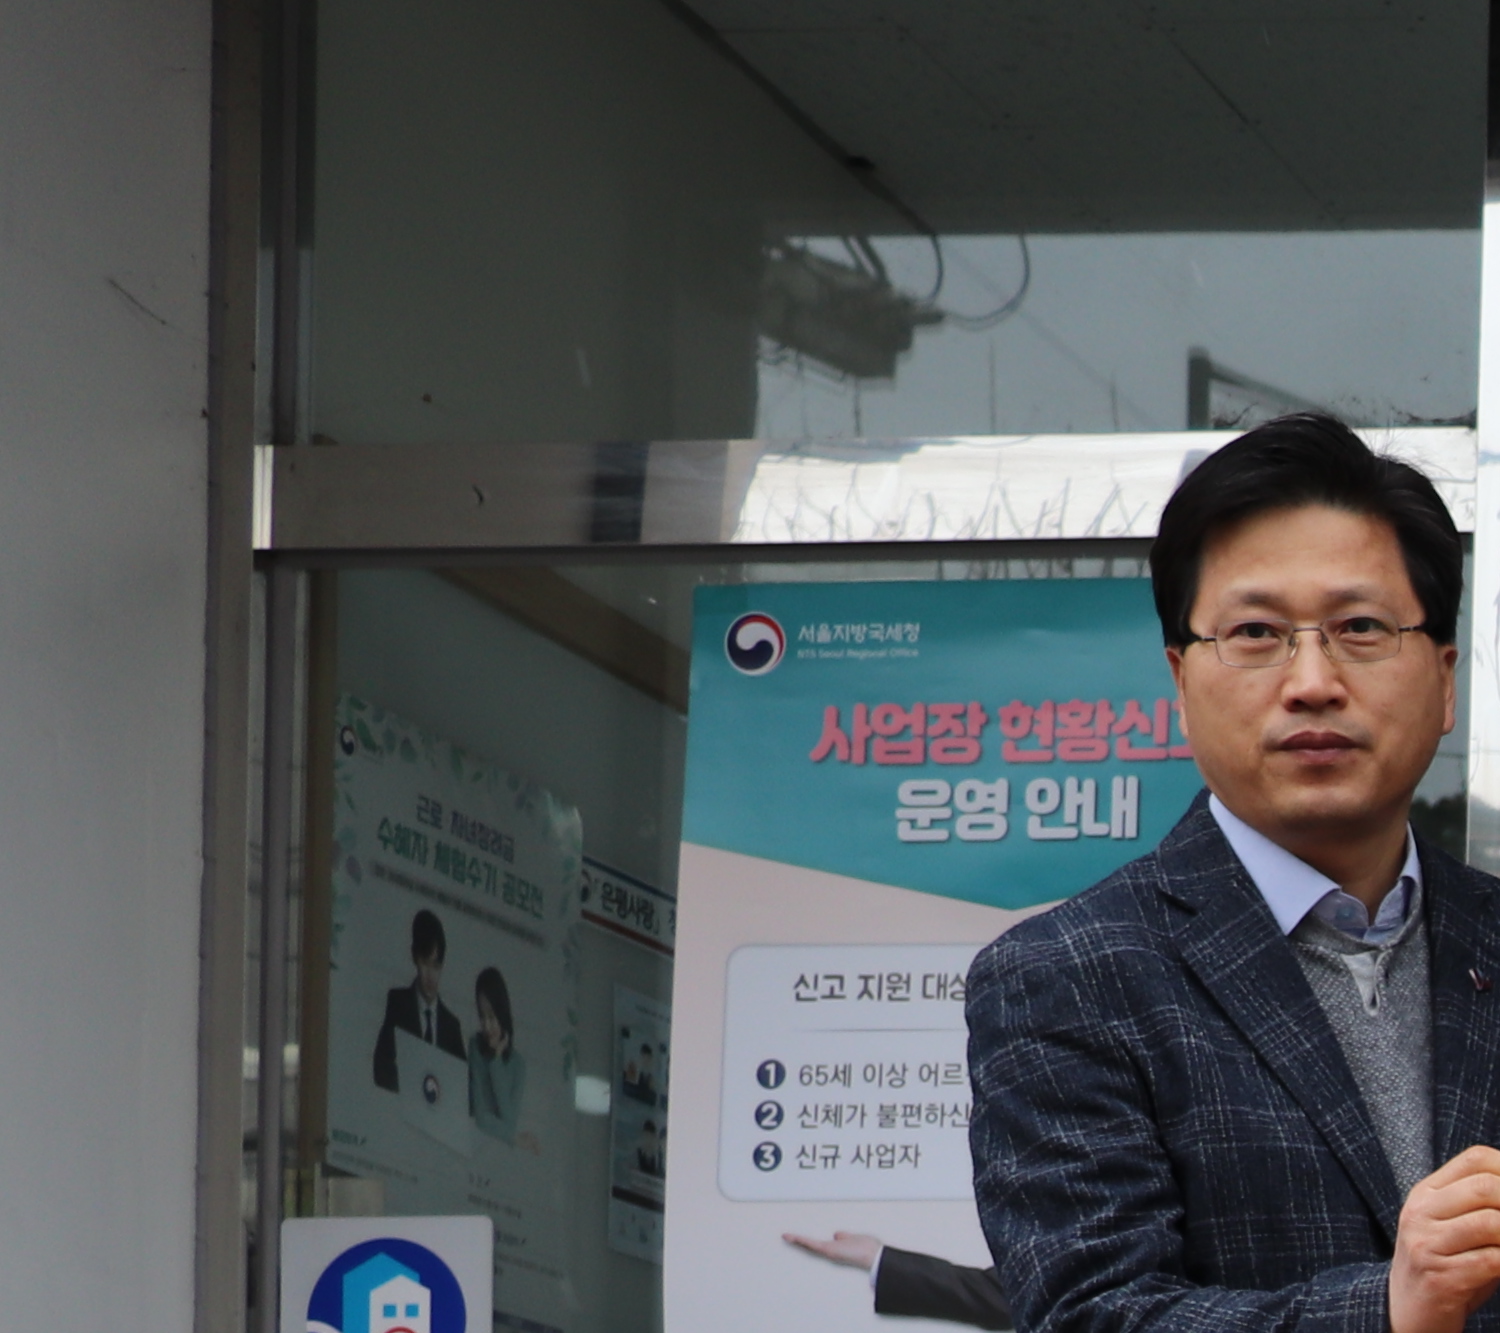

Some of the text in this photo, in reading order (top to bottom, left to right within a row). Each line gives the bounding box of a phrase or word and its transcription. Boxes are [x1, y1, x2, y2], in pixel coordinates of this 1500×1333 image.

[798, 622, 921, 644] 서울지방국세청
[809, 702, 988, 766] 사업장
[895, 775, 1140, 843] 운영 안내
[793, 973, 847, 1003] 신고
[857, 972, 911, 1002] 지원
[799, 1062, 973, 1087] 65세 이상 어르
[797, 1103, 868, 1129] 신체가
[795, 1144, 921, 1170] 신규 사업자
